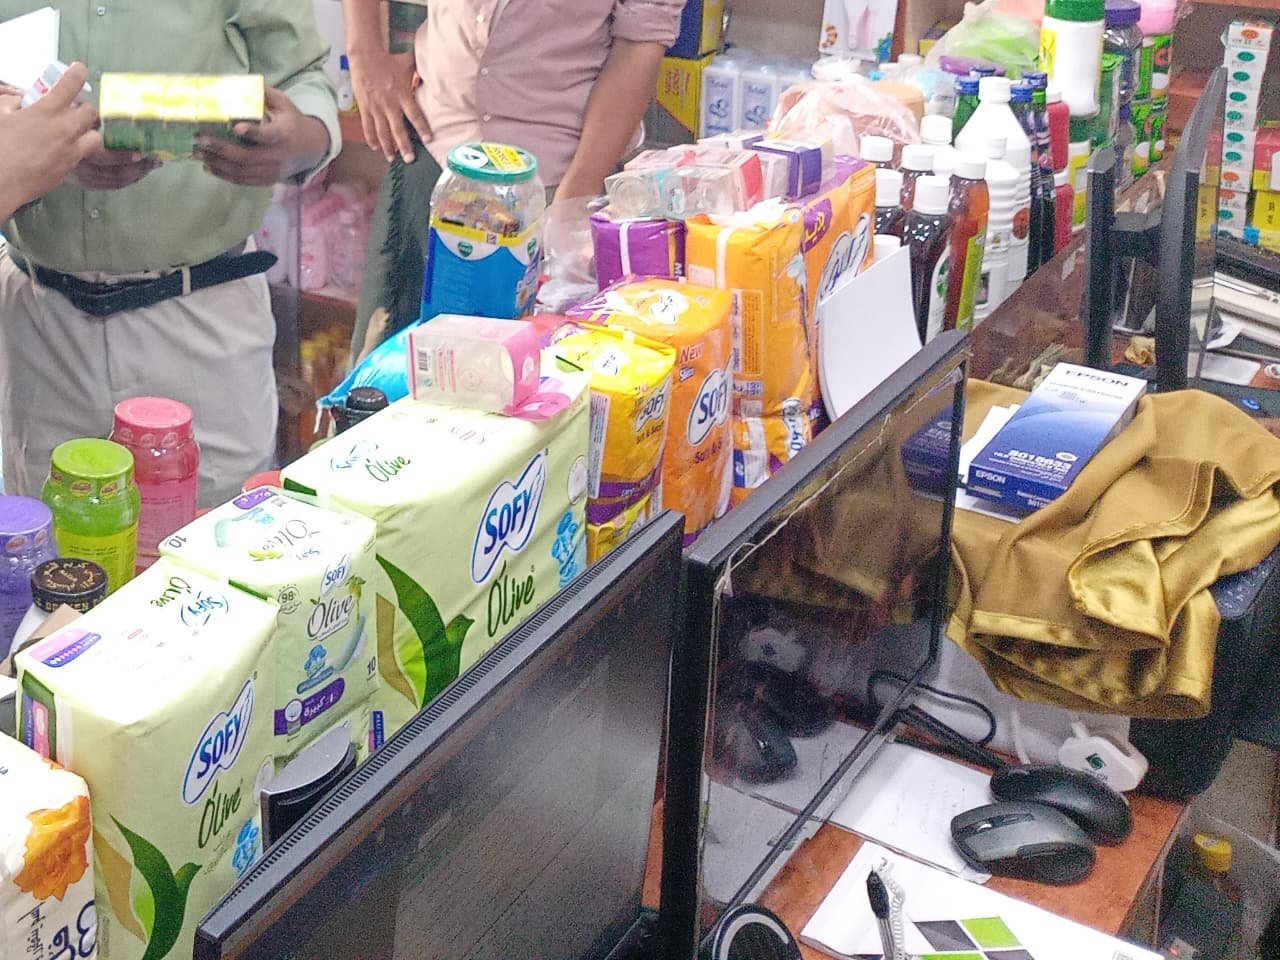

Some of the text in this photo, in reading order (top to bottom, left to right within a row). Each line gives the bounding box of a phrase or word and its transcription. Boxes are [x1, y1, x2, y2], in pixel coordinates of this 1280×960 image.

[1065, 370, 1129, 387] EPSON
[365, 454, 411, 483] Olive
[976, 470, 1007, 484] EPSON
[484, 489, 532, 556] SOFY
[169, 536, 187, 549] 10
[325, 564, 347, 587] SOFY
[150, 576, 192, 609] Olive
[487, 561, 536, 638] Olive
[307, 595, 354, 639] Olive
[367, 656, 377, 674] 10
[196, 713, 243, 780] SOFY
[198, 779, 243, 849] Olive
